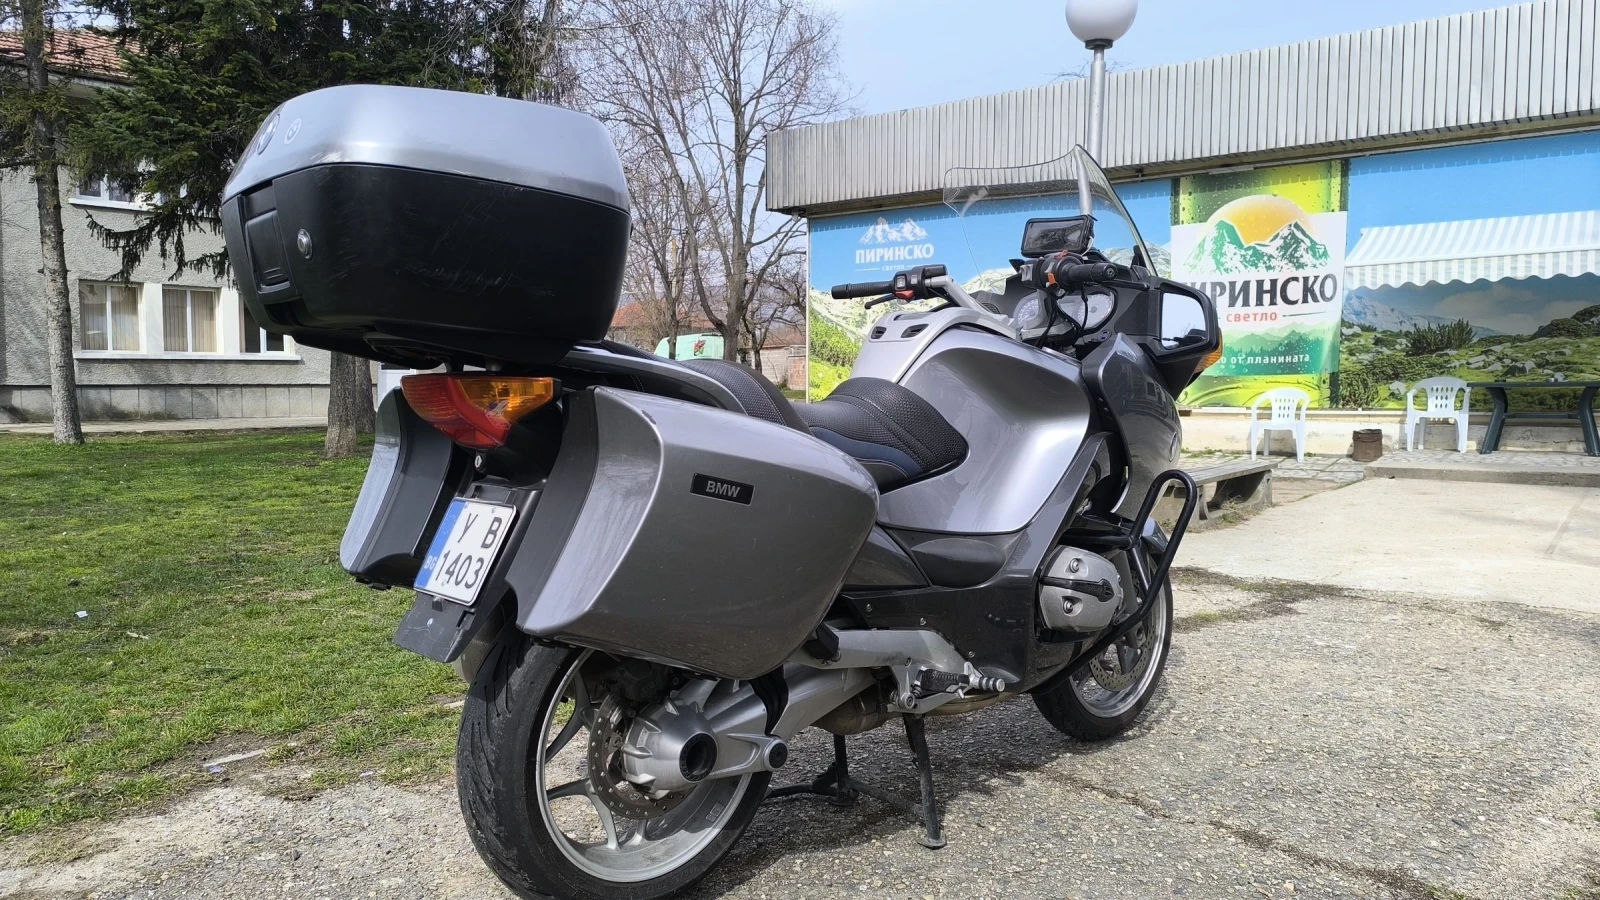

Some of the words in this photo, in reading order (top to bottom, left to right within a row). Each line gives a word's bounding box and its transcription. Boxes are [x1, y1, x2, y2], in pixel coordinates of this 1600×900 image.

[855, 243, 935, 264] ПИРИНСКО
[1183, 273, 1338, 308] РИНСКО
[1226, 311, 1278, 323] светло
[1230, 356, 1244, 364] от
[1247, 353, 1310, 364] планината
[705, 480, 741, 498] BMW
[435, 549, 485, 589] 1403
